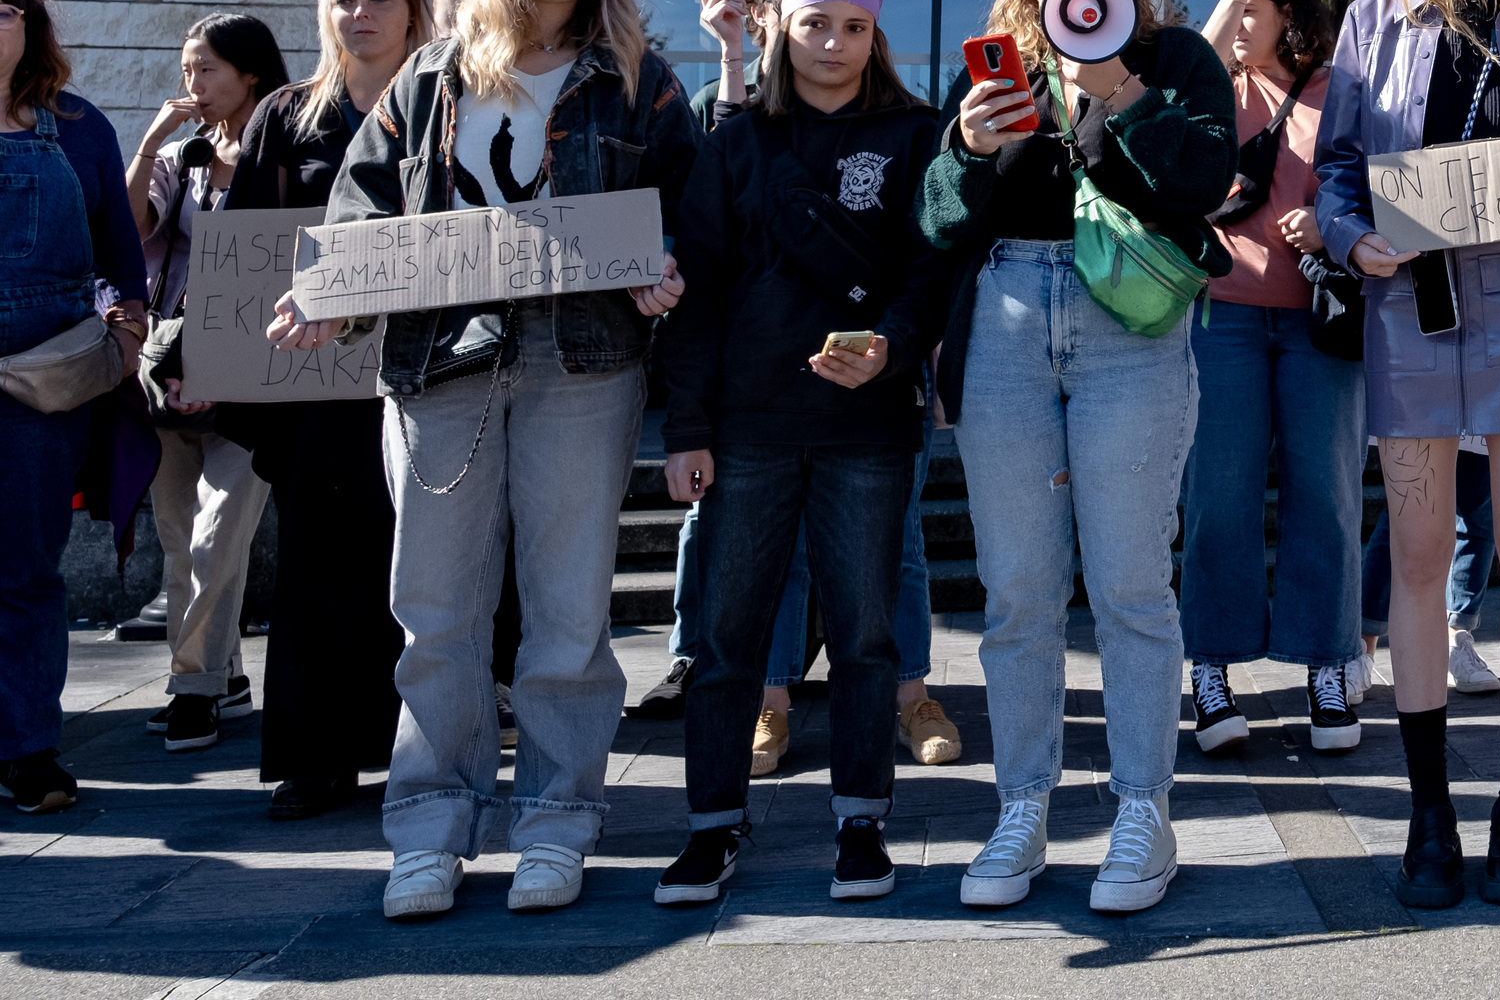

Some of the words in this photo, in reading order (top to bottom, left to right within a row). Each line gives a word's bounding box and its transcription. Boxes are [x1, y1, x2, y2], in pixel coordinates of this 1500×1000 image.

[846, 151, 886, 164] ELEMENT
[1380, 165, 1423, 202] ON
[1439, 156, 1487, 199] TE
[200, 230, 293, 278] HASE
[313, 229, 347, 259] LE
[372, 217, 462, 251] SEXE
[484, 205, 576, 233] N'EST
[305, 253, 419, 292] JAMAIS
[436, 245, 480, 277] UN
[498, 231, 584, 267] DEVOIR
[509, 257, 663, 290] CONJUGAL
[202, 286, 280, 336] EKI
[260, 342, 382, 387] DAKA
